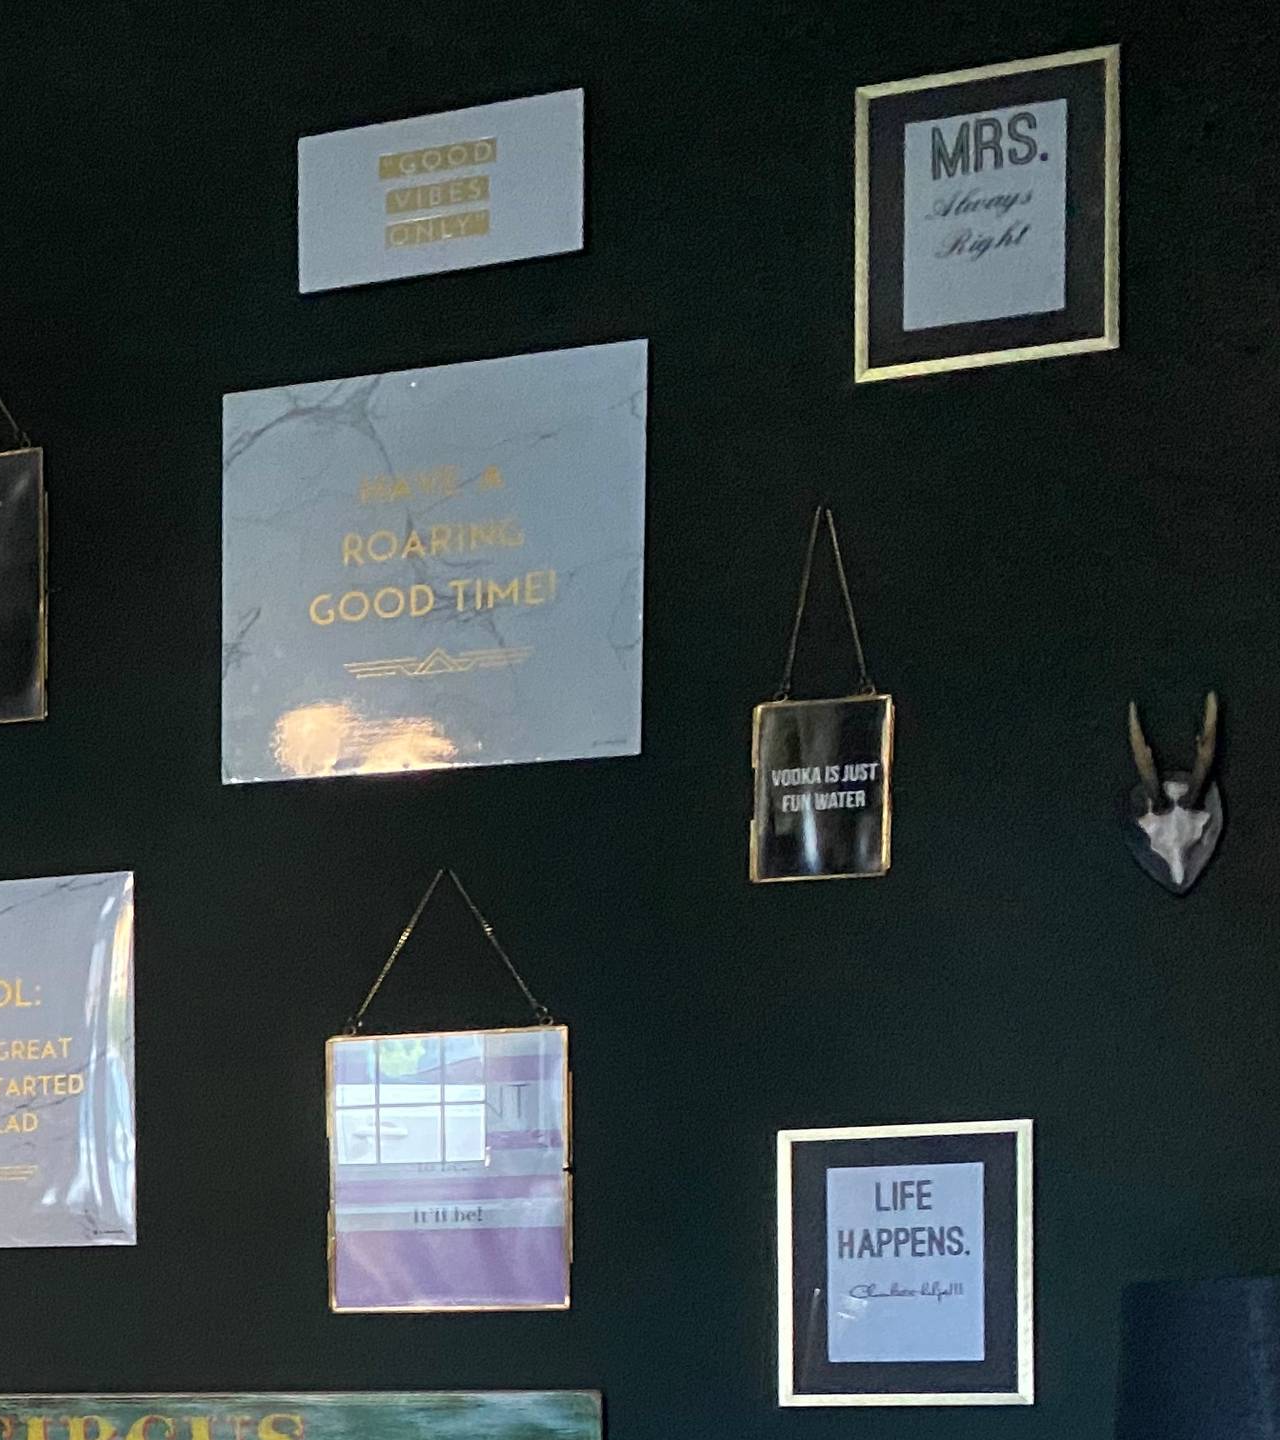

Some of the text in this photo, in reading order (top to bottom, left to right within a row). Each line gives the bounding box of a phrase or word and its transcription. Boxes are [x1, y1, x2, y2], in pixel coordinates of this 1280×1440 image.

[931, 111, 1049, 181] MRS.
[393, 180, 482, 207] VIBES
[924, 187, 1035, 221] Always
[935, 220, 1032, 262] Right
[477, 464, 504, 493] A
[341, 515, 525, 566] ROARING
[309, 569, 557, 626] GOOD TIME!
[772, 763, 880, 787] VODKA IS JUST
[782, 790, 866, 813] FUN WATER
[875, 1179, 933, 1212] LIFE
[838, 1226, 970, 1259] HAPPENS.
